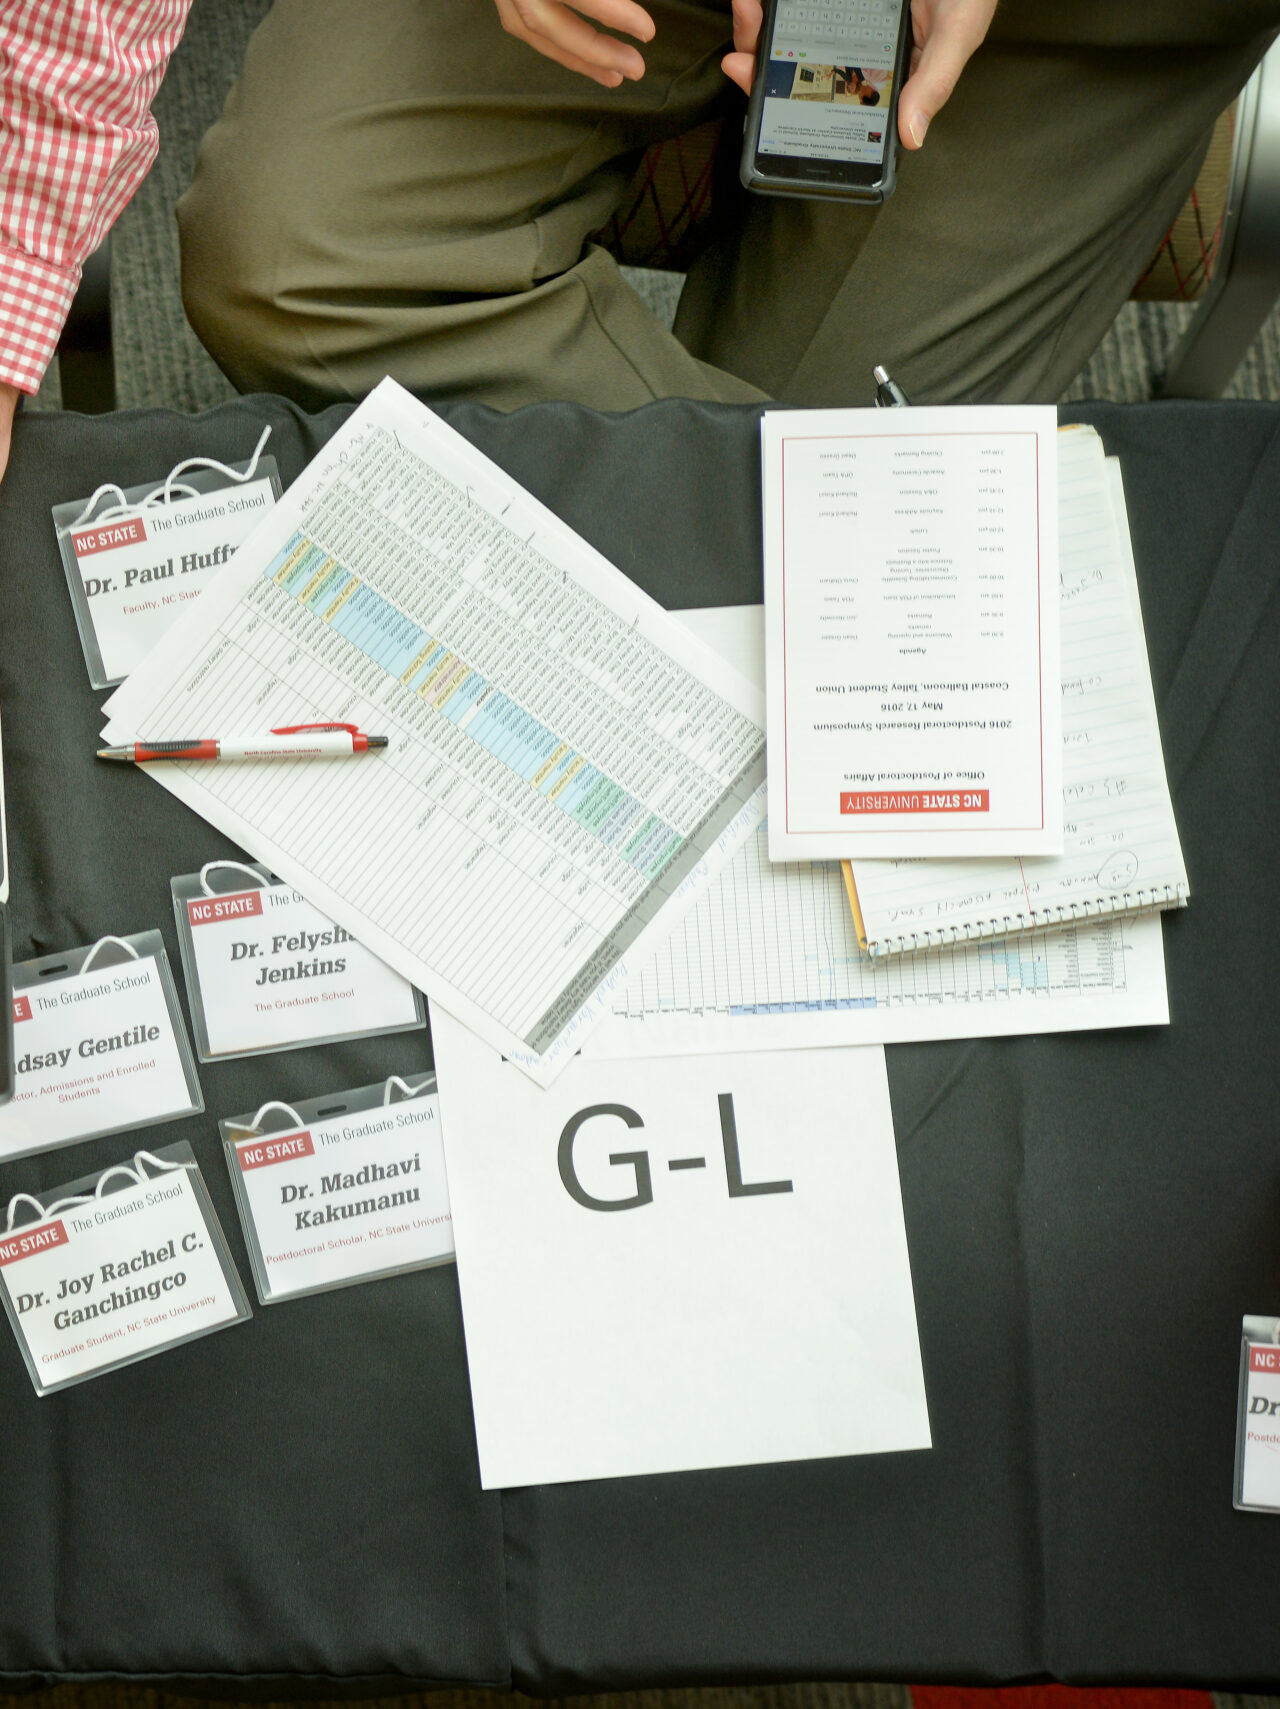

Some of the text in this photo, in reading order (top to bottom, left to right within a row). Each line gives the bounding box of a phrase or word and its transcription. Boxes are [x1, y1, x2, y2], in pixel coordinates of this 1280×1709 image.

[151, 493, 265, 532] The Graduate School
[76, 524, 137, 551] NC STATE
[84, 577, 117, 597] Dr.
[124, 558, 174, 588] Paul
[122, 601, 160, 615] Faculty,
[161, 595, 176, 605] NC
[898, 647, 926, 655] Agenda
[815, 682, 1009, 693] Coastal Ballroom, Talley Student Union
[880, 701, 943, 712] May 17, 2016
[812, 720, 1011, 730] 2016 Postdoctoral Research Symposium
[843, 773, 875, 781] Affairs
[877, 771, 940, 781] Postdoctoral
[955, 771, 984, 779] Office
[846, 793, 981, 809] NC STATE UNIVERSITY
[192, 897, 253, 920] NC STATE
[269, 894, 289, 906] The
[230, 942, 264, 961] Dr.
[255, 957, 346, 985] Jenkins
[37, 971, 151, 1010] The Graduate School
[255, 988, 354, 1012] The Graduate School
[77, 1024, 160, 1058] Gentile
[39, 1076, 94, 1095] Admissions
[96, 1069, 114, 1081] and
[115, 1058, 156, 1076] Enrolled
[57, 1087, 100, 1103] Students
[319, 1107, 434, 1146] The Graduate School
[244, 1138, 305, 1164] NC STATE
[556, 1092, 793, 1212] G-L
[280, 1153, 420, 1204] Dr. Madhavi
[71, 1182, 183, 1232] The Graduate School
[294, 1187, 420, 1230] Kakumanu
[19, 1227, 59, 1252] STATE
[265, 1243, 325, 1264] Postdoctoral
[327, 1235, 367, 1249] Scholar,
[368, 1229, 380, 1239] NC
[385, 1224, 410, 1234] State
[16, 1231, 203, 1314] Dr. Joy Rachel C.
[53, 1271, 186, 1330] Ganchingco
[41, 1295, 216, 1362] Graduate Student, NC State University
[1254, 1353, 1274, 1367] NC
